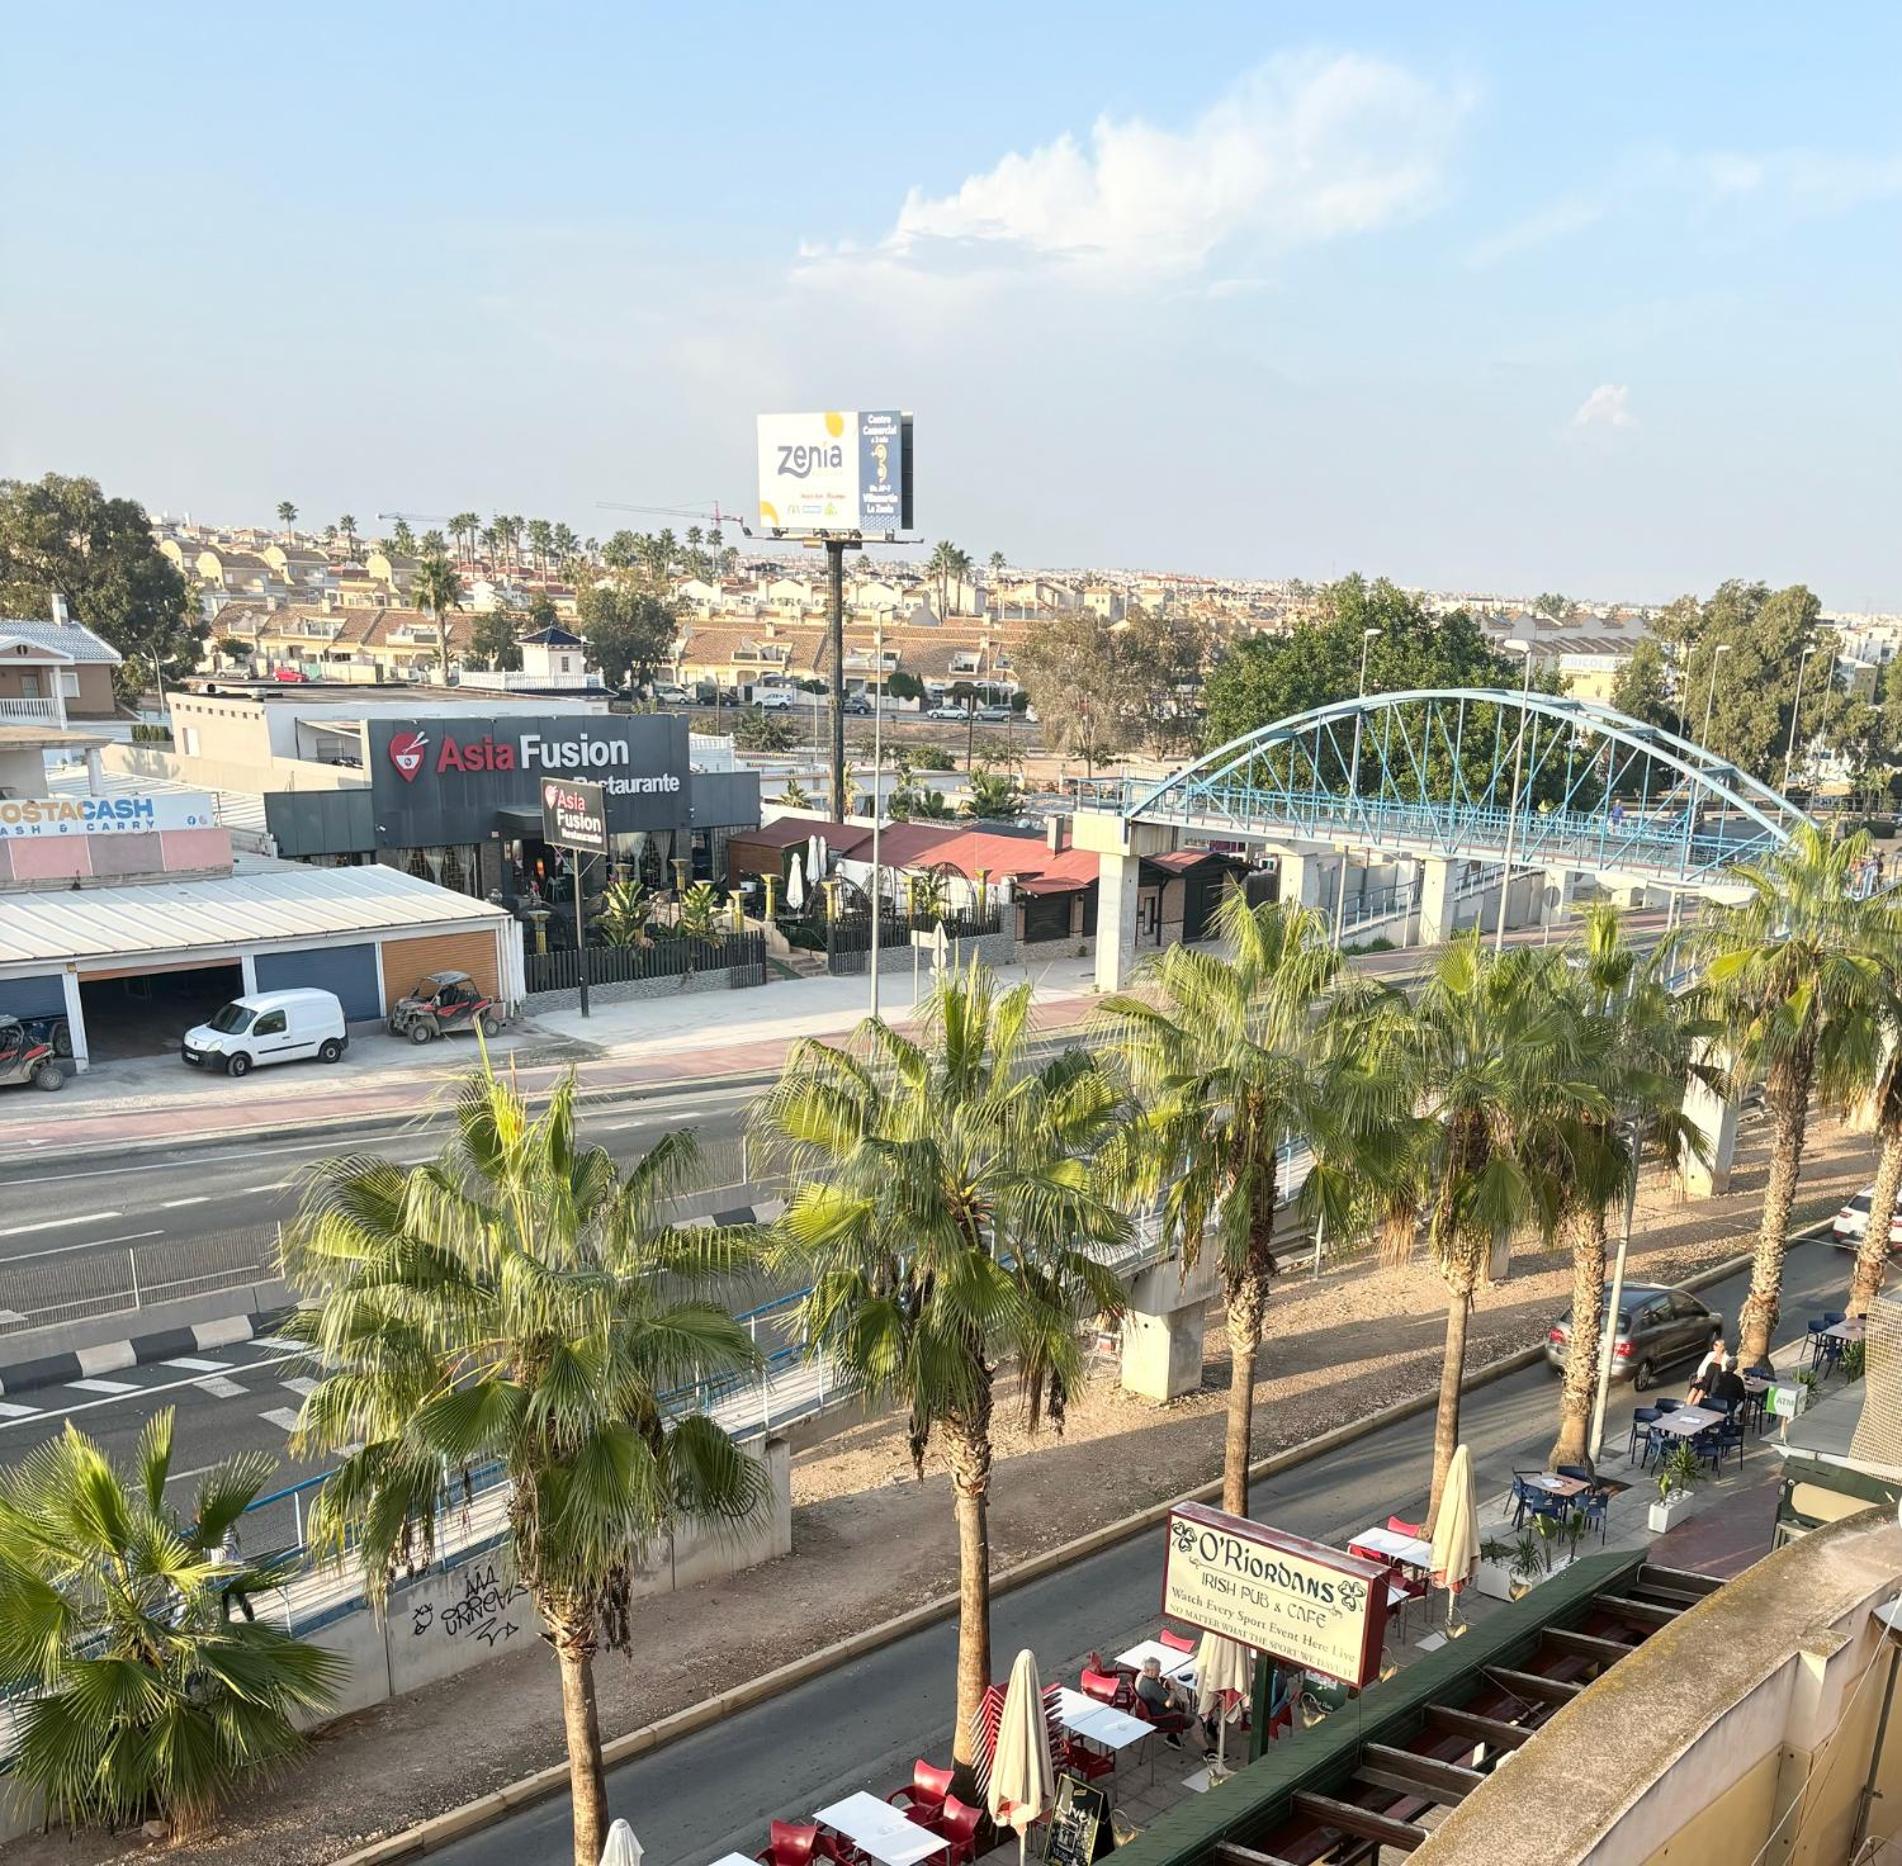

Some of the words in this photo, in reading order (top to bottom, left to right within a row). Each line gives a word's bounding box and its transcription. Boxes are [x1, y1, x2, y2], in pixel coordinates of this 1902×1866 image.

[437, 734, 515, 773] Asia
[519, 733, 629, 769] Fusion
[0, 798, 154, 824] OSTACASH
[557, 789, 586, 811] Asia
[59, 823, 68, 833] &
[86, 820, 155, 832] CARRY
[556, 808, 602, 833] Fusion
[1202, 1571, 1236, 1597] IRISH
[1240, 1585, 1269, 1608] PUB
[1273, 1602, 1282, 1613] &
[1287, 1603, 1327, 1628] CAFE
[1169, 1603, 1184, 1614] NO
[1185, 1609, 1220, 1627] MATTER
[1221, 1622, 1247, 1638] WHAT
[1248, 1633, 1268, 1646] THE
[1172, 1587, 1203, 1607] Watch
[1206, 1600, 1234, 1619] Every
[1237, 1610, 1266, 1629] Sport
[1269, 1622, 1298, 1642] Event
[1302, 1634, 1329, 1652] Here
[1332, 1644, 1356, 1662] Live
